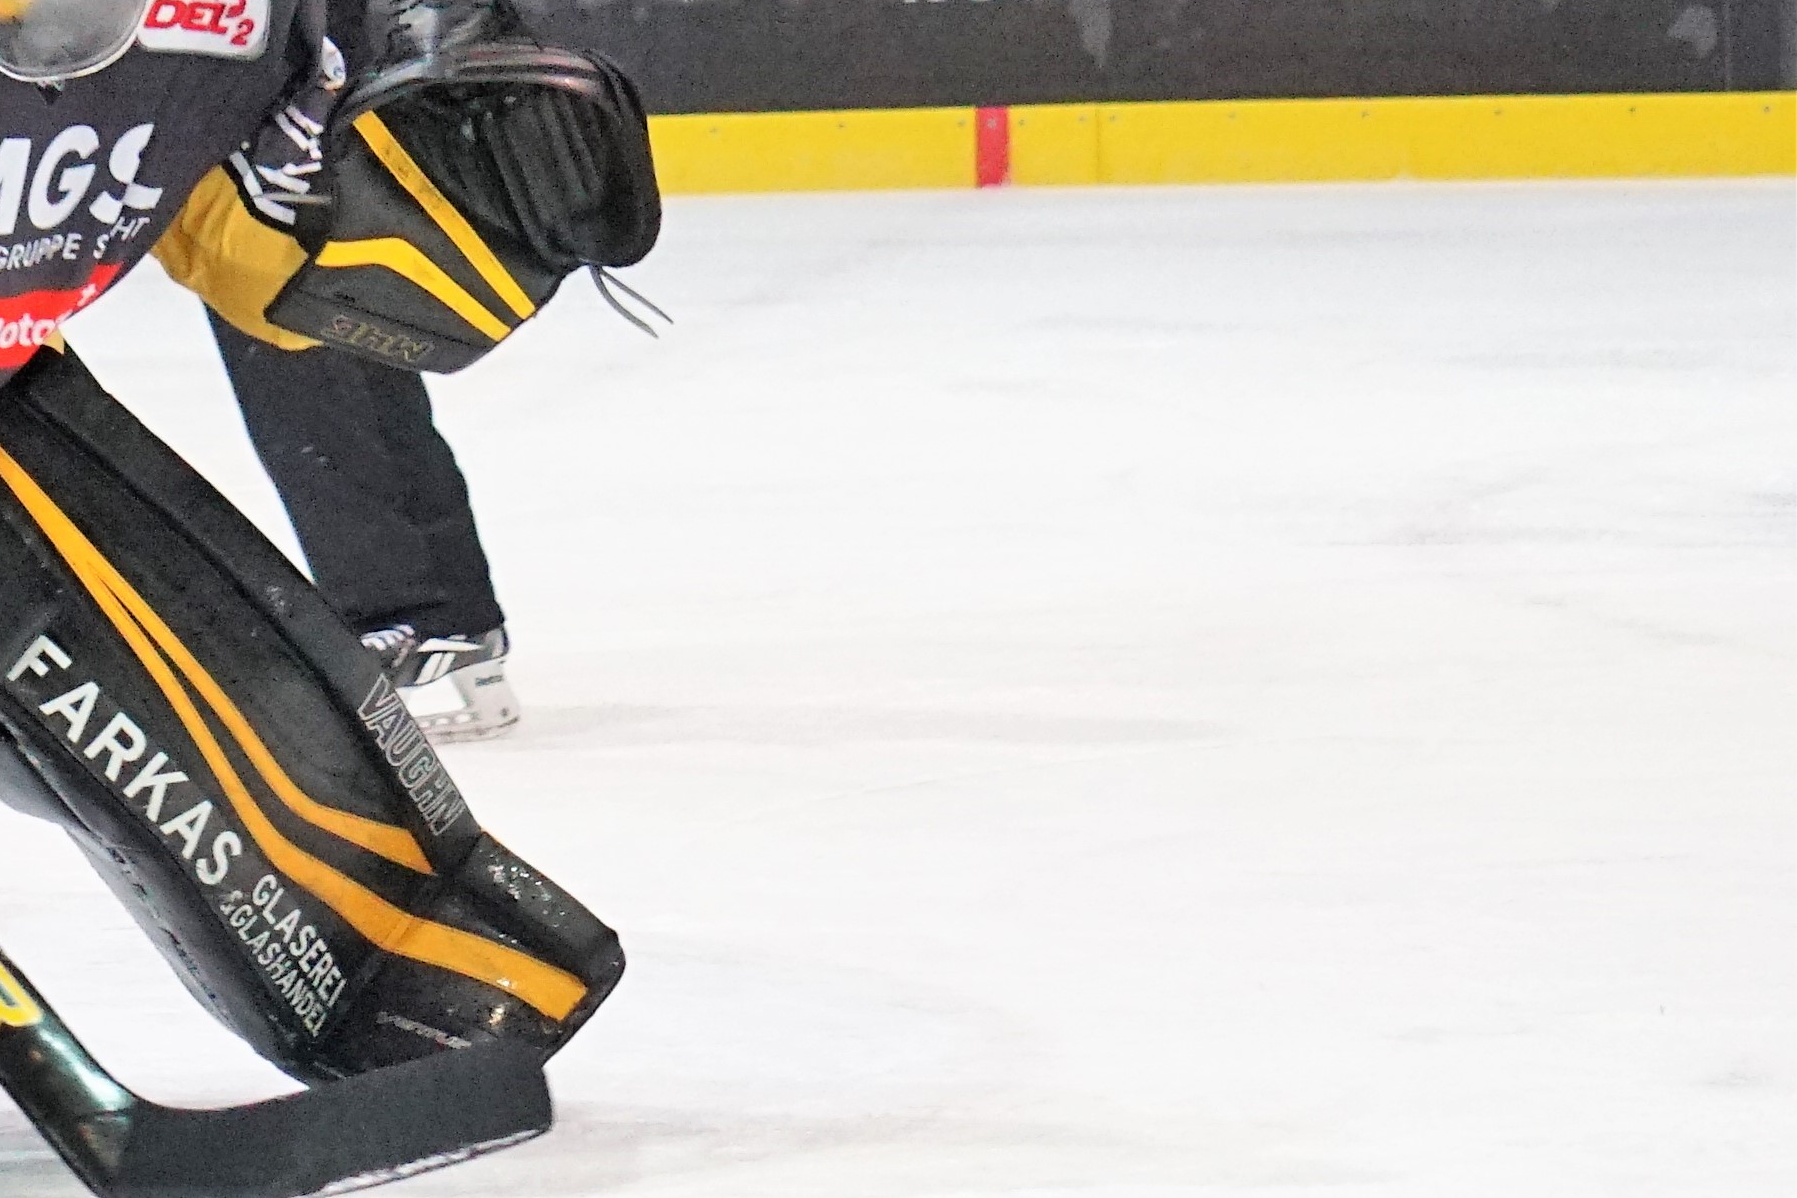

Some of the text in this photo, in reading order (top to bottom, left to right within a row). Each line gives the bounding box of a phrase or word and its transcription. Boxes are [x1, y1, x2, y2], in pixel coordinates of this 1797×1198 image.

[5, 634, 244, 886] FARKAS
[356, 671, 466, 837] VAUGHN
[253, 873, 348, 1009] GLASEREI
